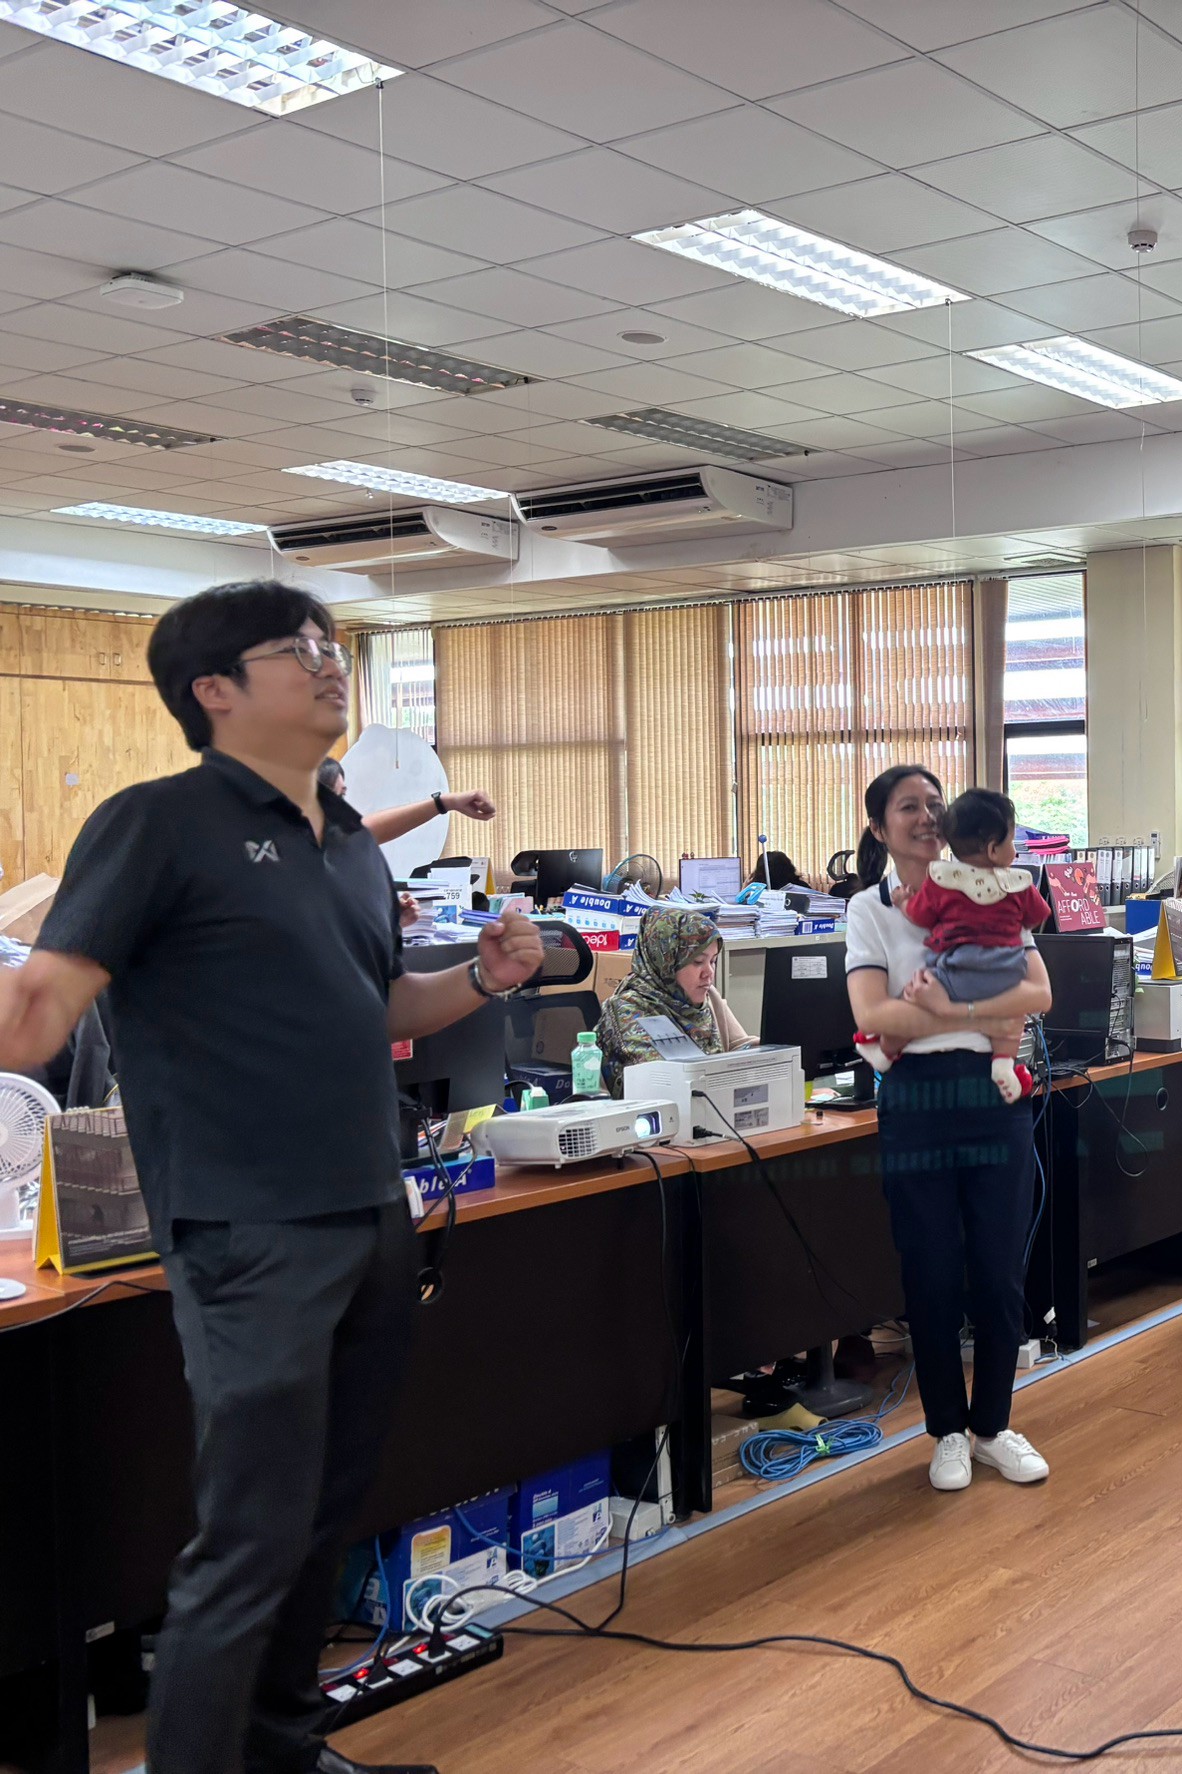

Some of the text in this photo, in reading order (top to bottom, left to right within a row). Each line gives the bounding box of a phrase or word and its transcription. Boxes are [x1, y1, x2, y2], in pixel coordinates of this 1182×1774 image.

[571, 895, 611, 909] Double A
[1058, 898, 1090, 913] AFFORD
[1081, 911, 1101, 925] ABLE
